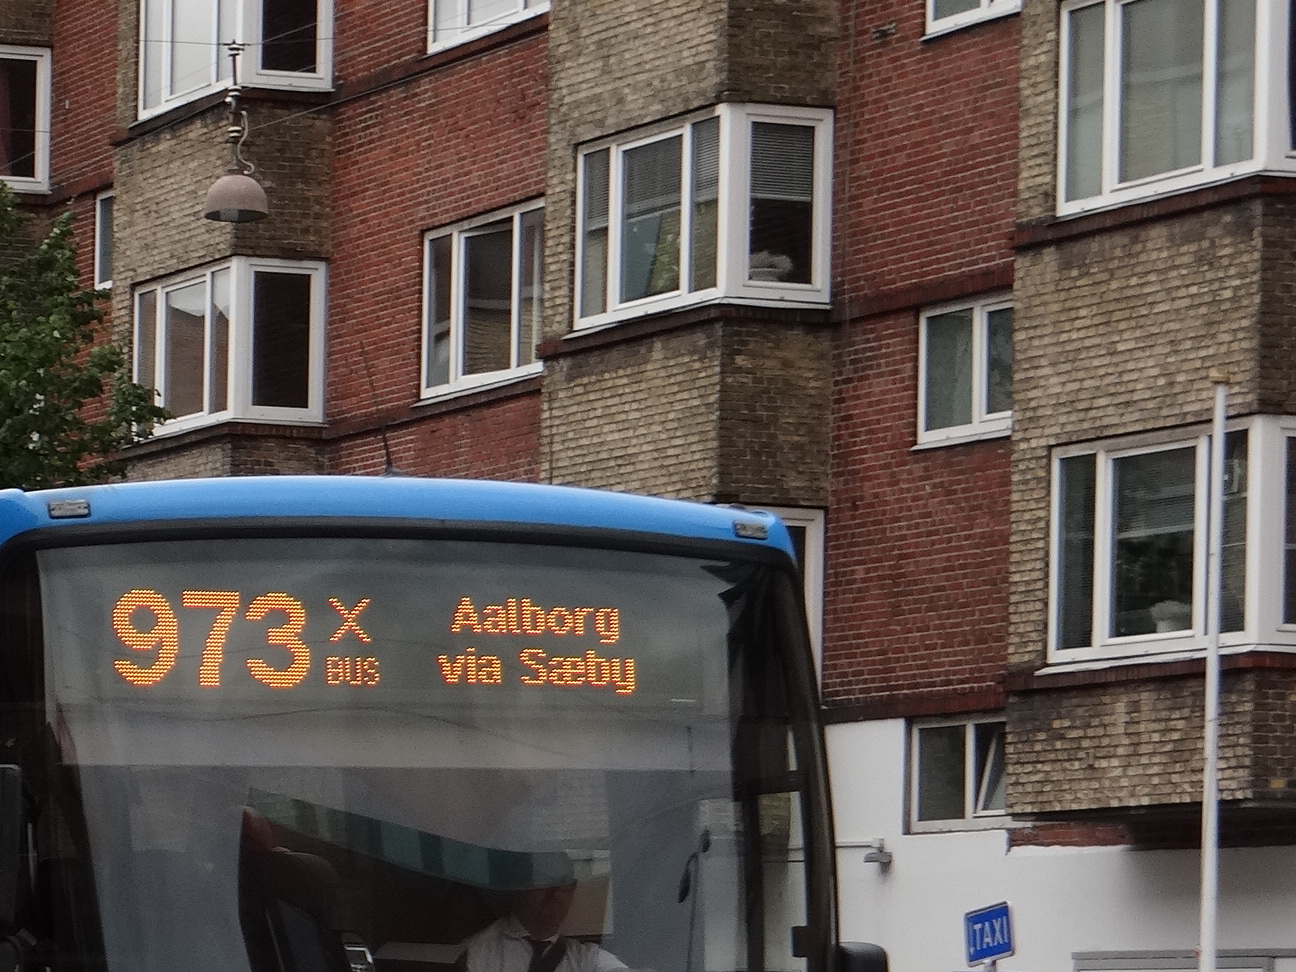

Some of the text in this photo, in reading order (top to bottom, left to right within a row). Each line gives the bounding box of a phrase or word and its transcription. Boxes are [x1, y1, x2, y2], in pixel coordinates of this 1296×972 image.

[112, 588, 311, 688] 973
[327, 597, 372, 643] X
[451, 596, 620, 644] Aalborg
[326, 656, 380, 686] BUS
[438, 647, 636, 694] via Sæby
[973, 916, 1009, 951] TAXI
